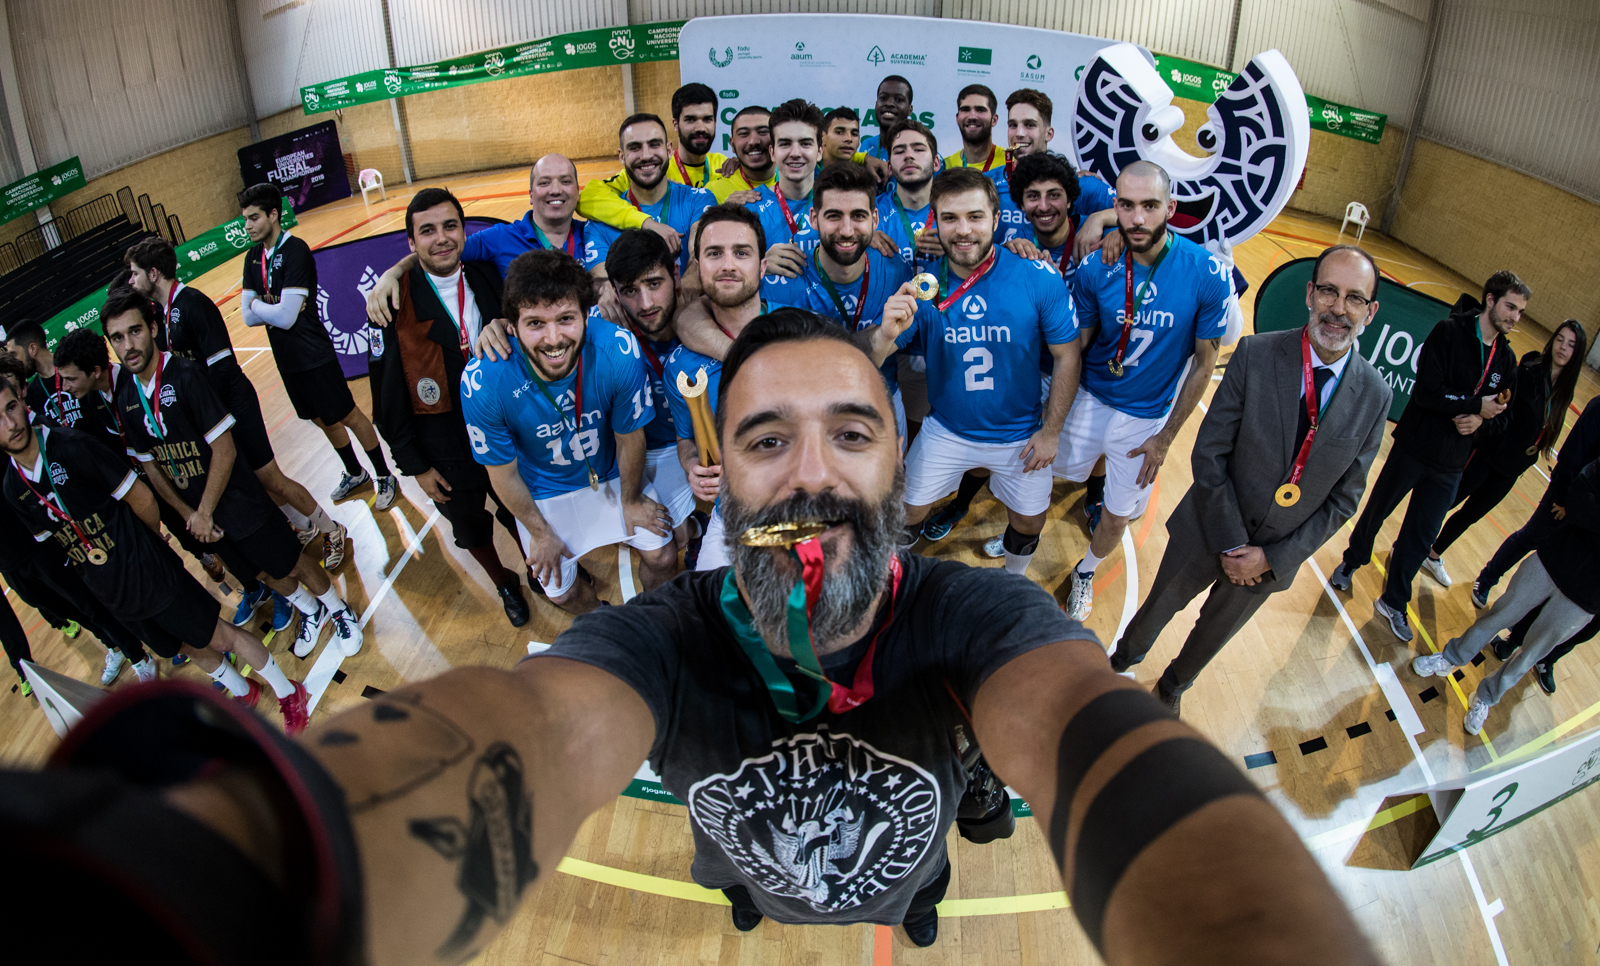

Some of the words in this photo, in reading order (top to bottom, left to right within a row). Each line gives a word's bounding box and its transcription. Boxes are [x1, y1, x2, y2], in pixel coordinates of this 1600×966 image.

[648, 27, 682, 35] CAMPEONA
[576, 42, 597, 54] JOGOS
[609, 36, 635, 49] CNU
[383, 75, 402, 86] CNU
[1020, 72, 1045, 81] SASUM
[1182, 74, 1202, 84] JOGOS
[1212, 79, 1229, 90] CN
[1322, 109, 1343, 124] CNU
[275, 149, 305, 164] EUROPEAN
[276, 152, 314, 169] UNIVERSITIES
[61, 168, 79, 181] JOGOS
[266, 160, 310, 182] FUTSAL
[280, 164, 322, 183] CHAMPIONSHIP
[225, 227, 248, 242] CNU
[199, 241, 217, 256] JOGOS
[77, 307, 99, 328] JOGOS
[944, 325, 1011, 344] aaum
[1121, 327, 1154, 367] 7
[963, 346, 994, 391] 2
[536, 409, 602, 438] aaum
[546, 428, 600, 466] 18
[890, 777, 936, 844] JOEY
[1466, 781, 1519, 841] 3
